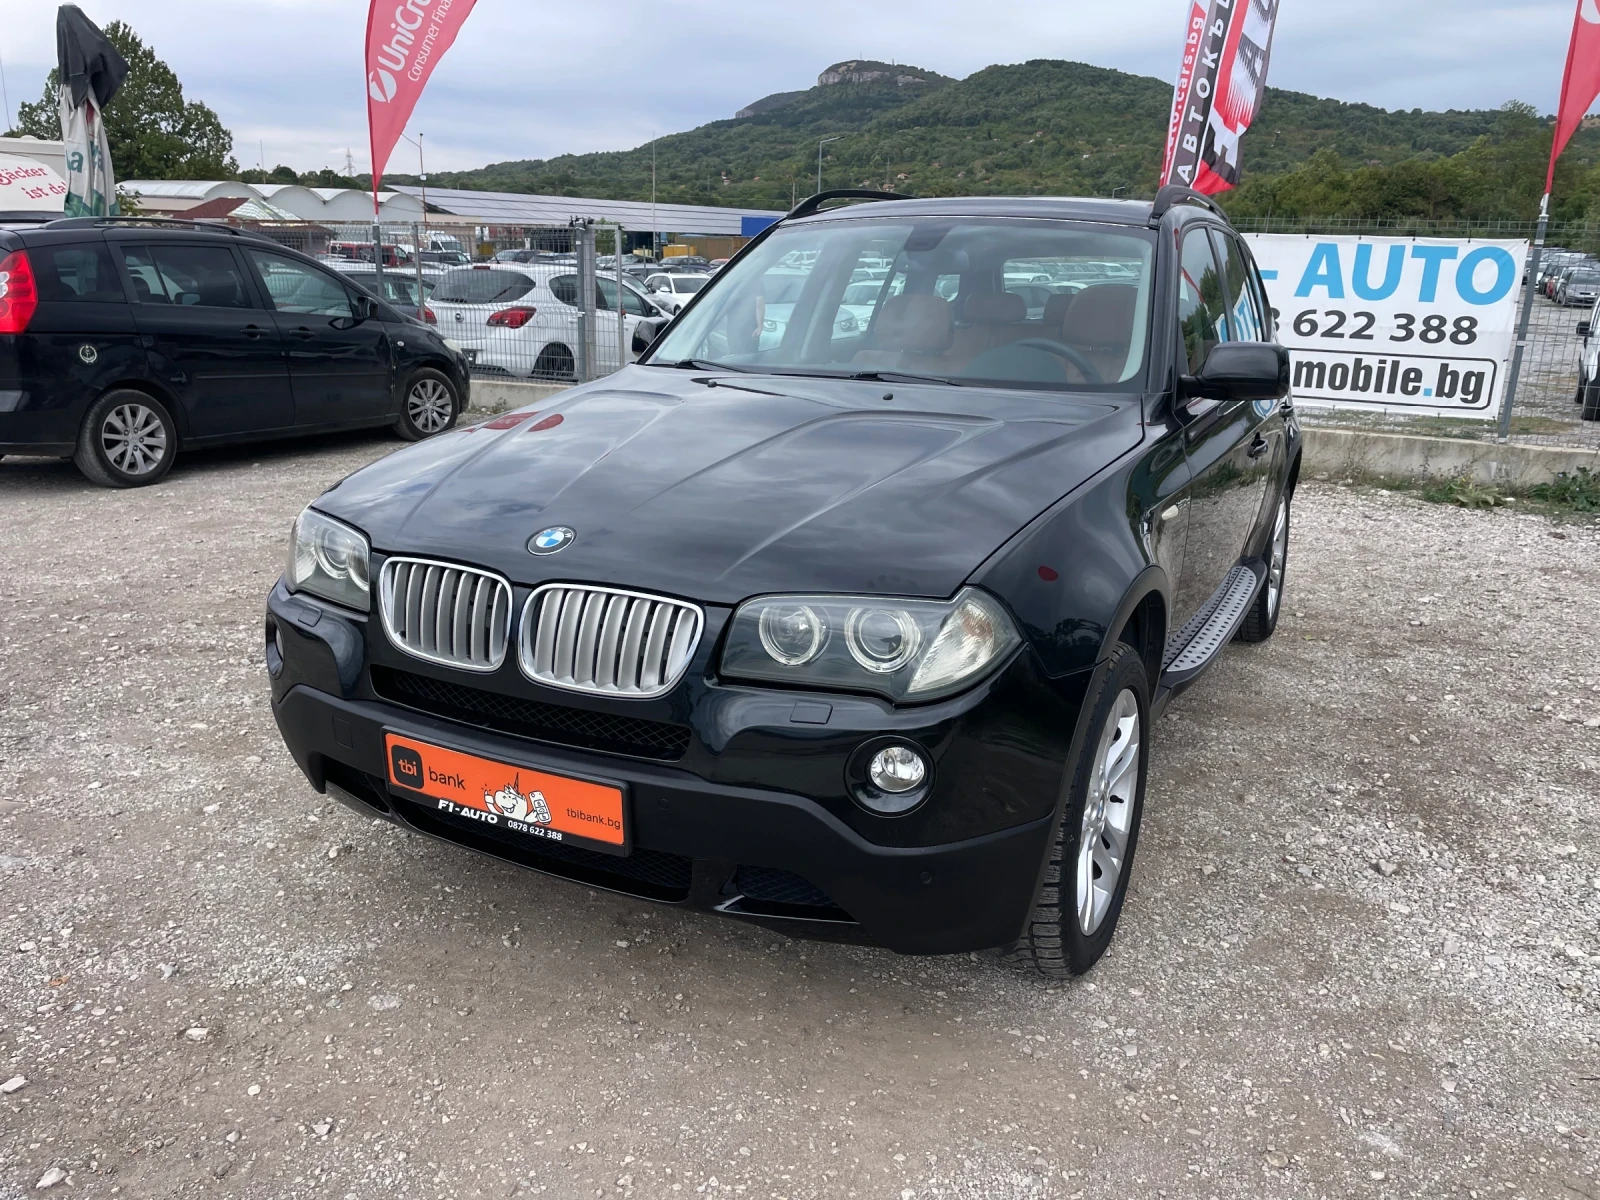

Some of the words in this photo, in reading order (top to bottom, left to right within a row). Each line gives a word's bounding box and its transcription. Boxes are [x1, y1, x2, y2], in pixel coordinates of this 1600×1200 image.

[408, 23, 439, 81] Consumer
[432, 0, 454, 23] Fina
[21, 186, 49, 199] ist
[1293, 242, 1516, 306] AUTO
[1293, 309, 1376, 341] 622
[1388, 312, 1479, 346] 388
[1292, 357, 1486, 404] mobile.bg
[397, 758, 418, 777] tbi
[428, 766, 466, 791] bank
[437, 798, 498, 824] F1-AUTO
[566, 807, 621, 830] tbibank.bg
[507, 819, 528, 833] 0878
[529, 824, 545, 838] 622
[546, 829, 563, 842] 388
